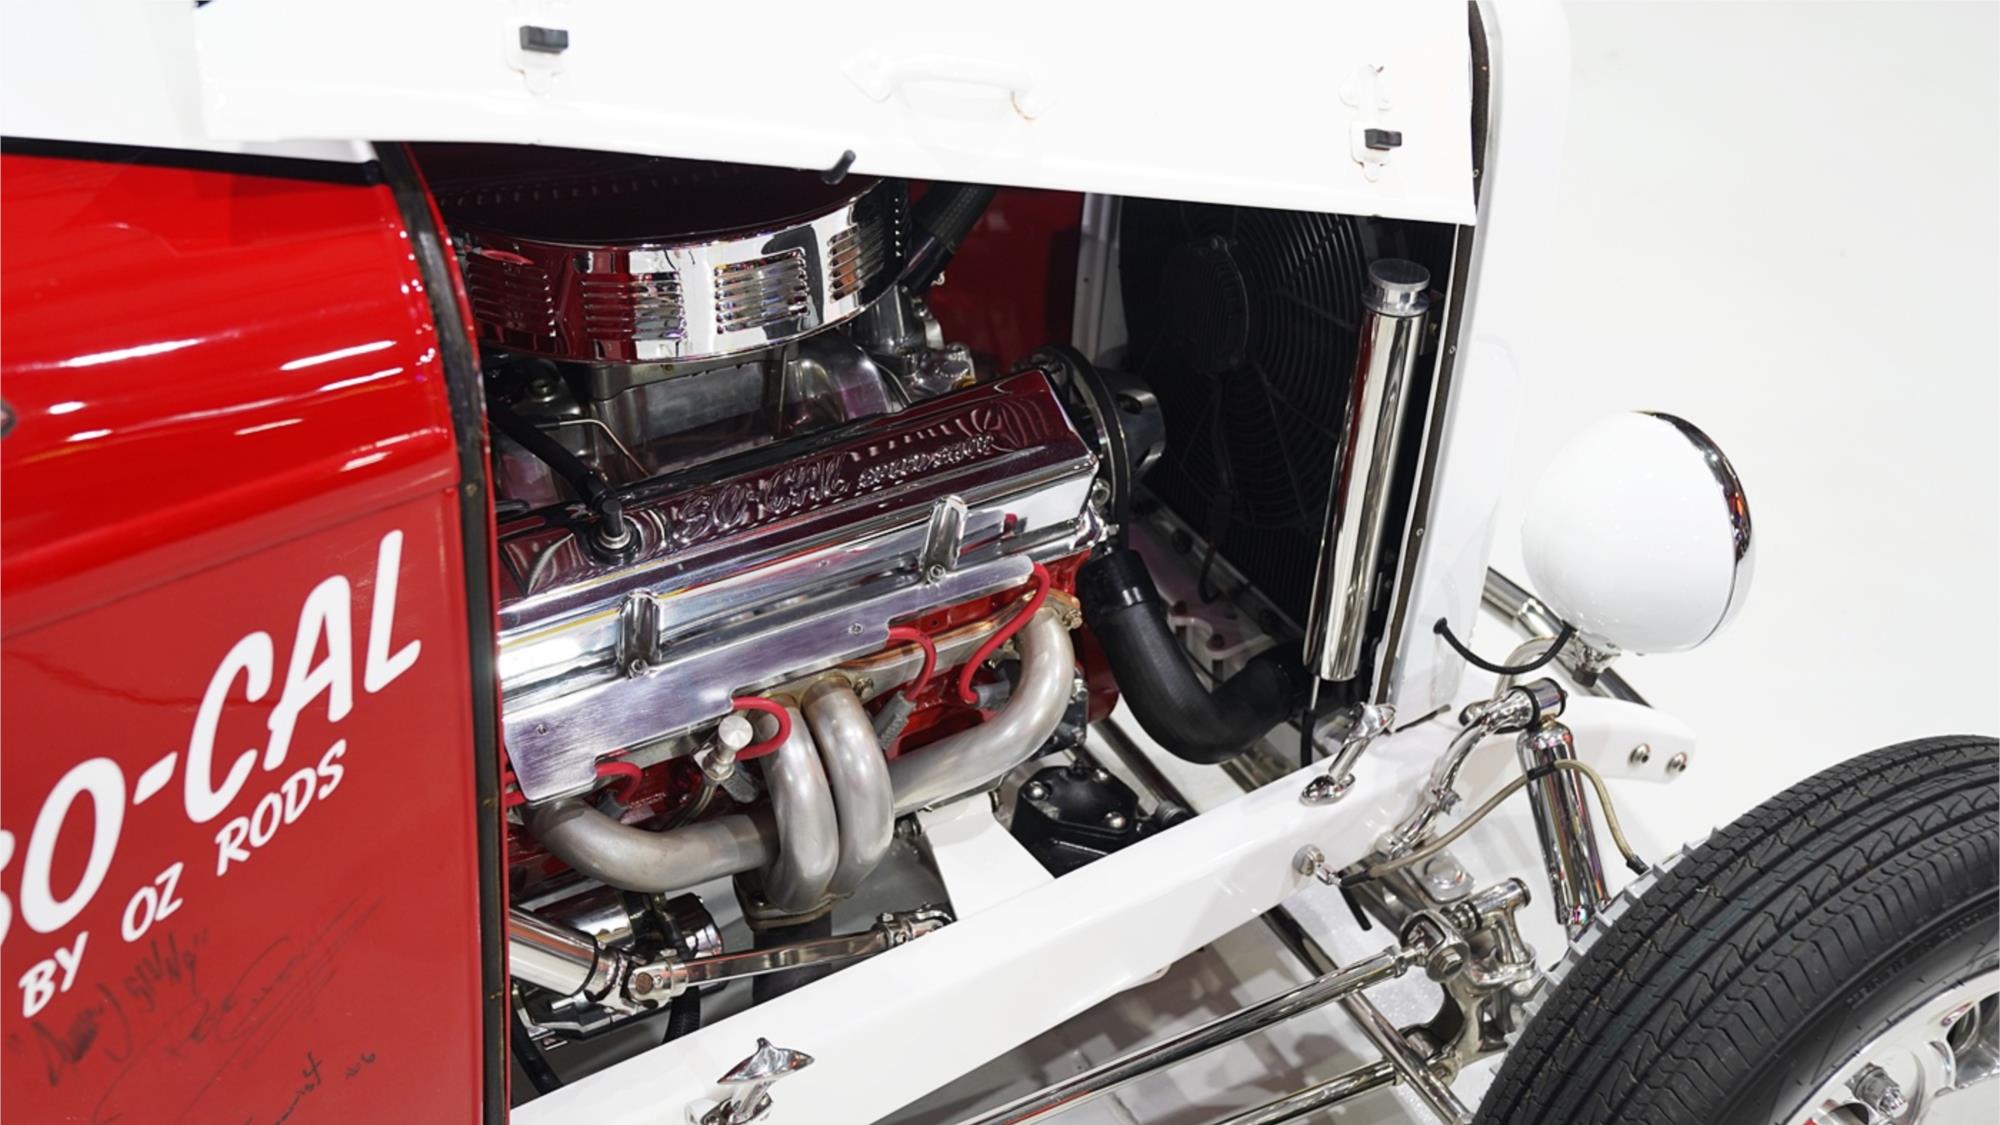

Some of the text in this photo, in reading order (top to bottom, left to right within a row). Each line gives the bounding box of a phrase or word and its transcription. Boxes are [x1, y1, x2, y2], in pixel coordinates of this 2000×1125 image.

[0, 530, 421, 948] O-CAL
[19, 932, 88, 1017] BY
[122, 863, 183, 941] OZ
[216, 739, 346, 876] RODS
